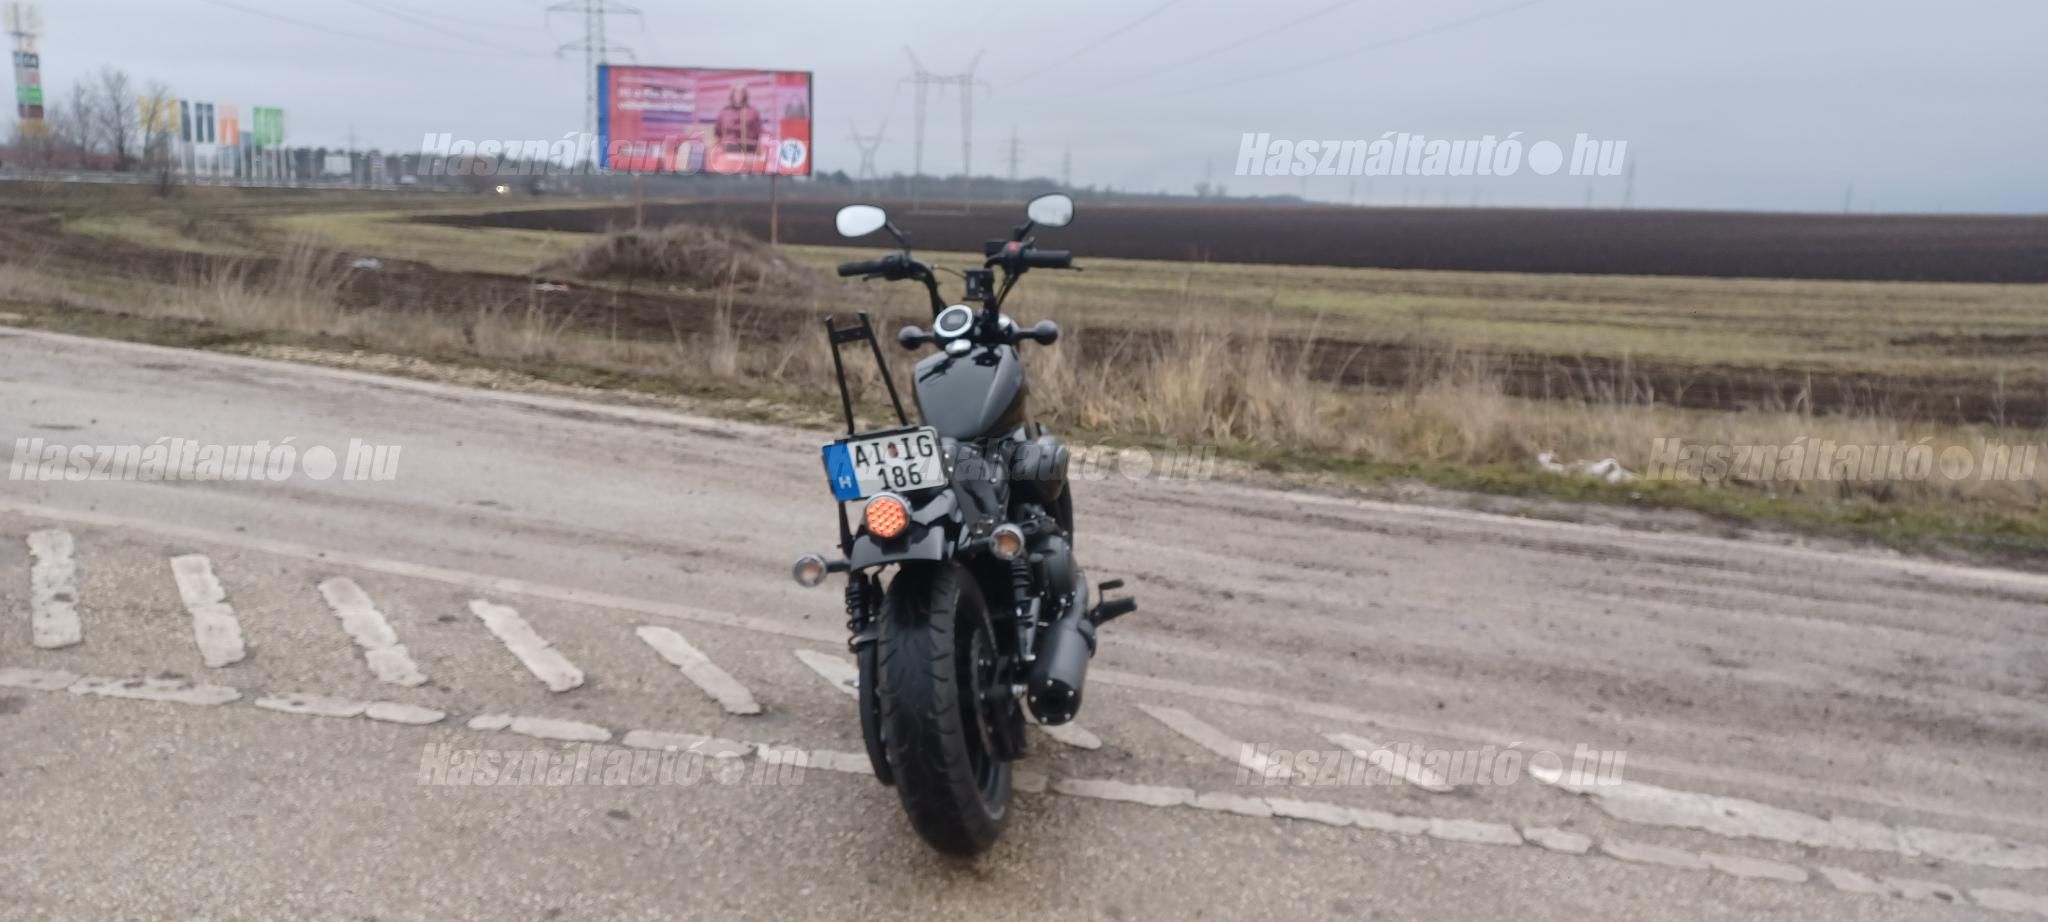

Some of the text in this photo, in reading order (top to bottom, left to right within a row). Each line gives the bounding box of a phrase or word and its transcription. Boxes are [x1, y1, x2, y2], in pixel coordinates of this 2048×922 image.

[855, 435, 933, 467] AI IG
[838, 476, 852, 489] H
[878, 463, 922, 490] 186
